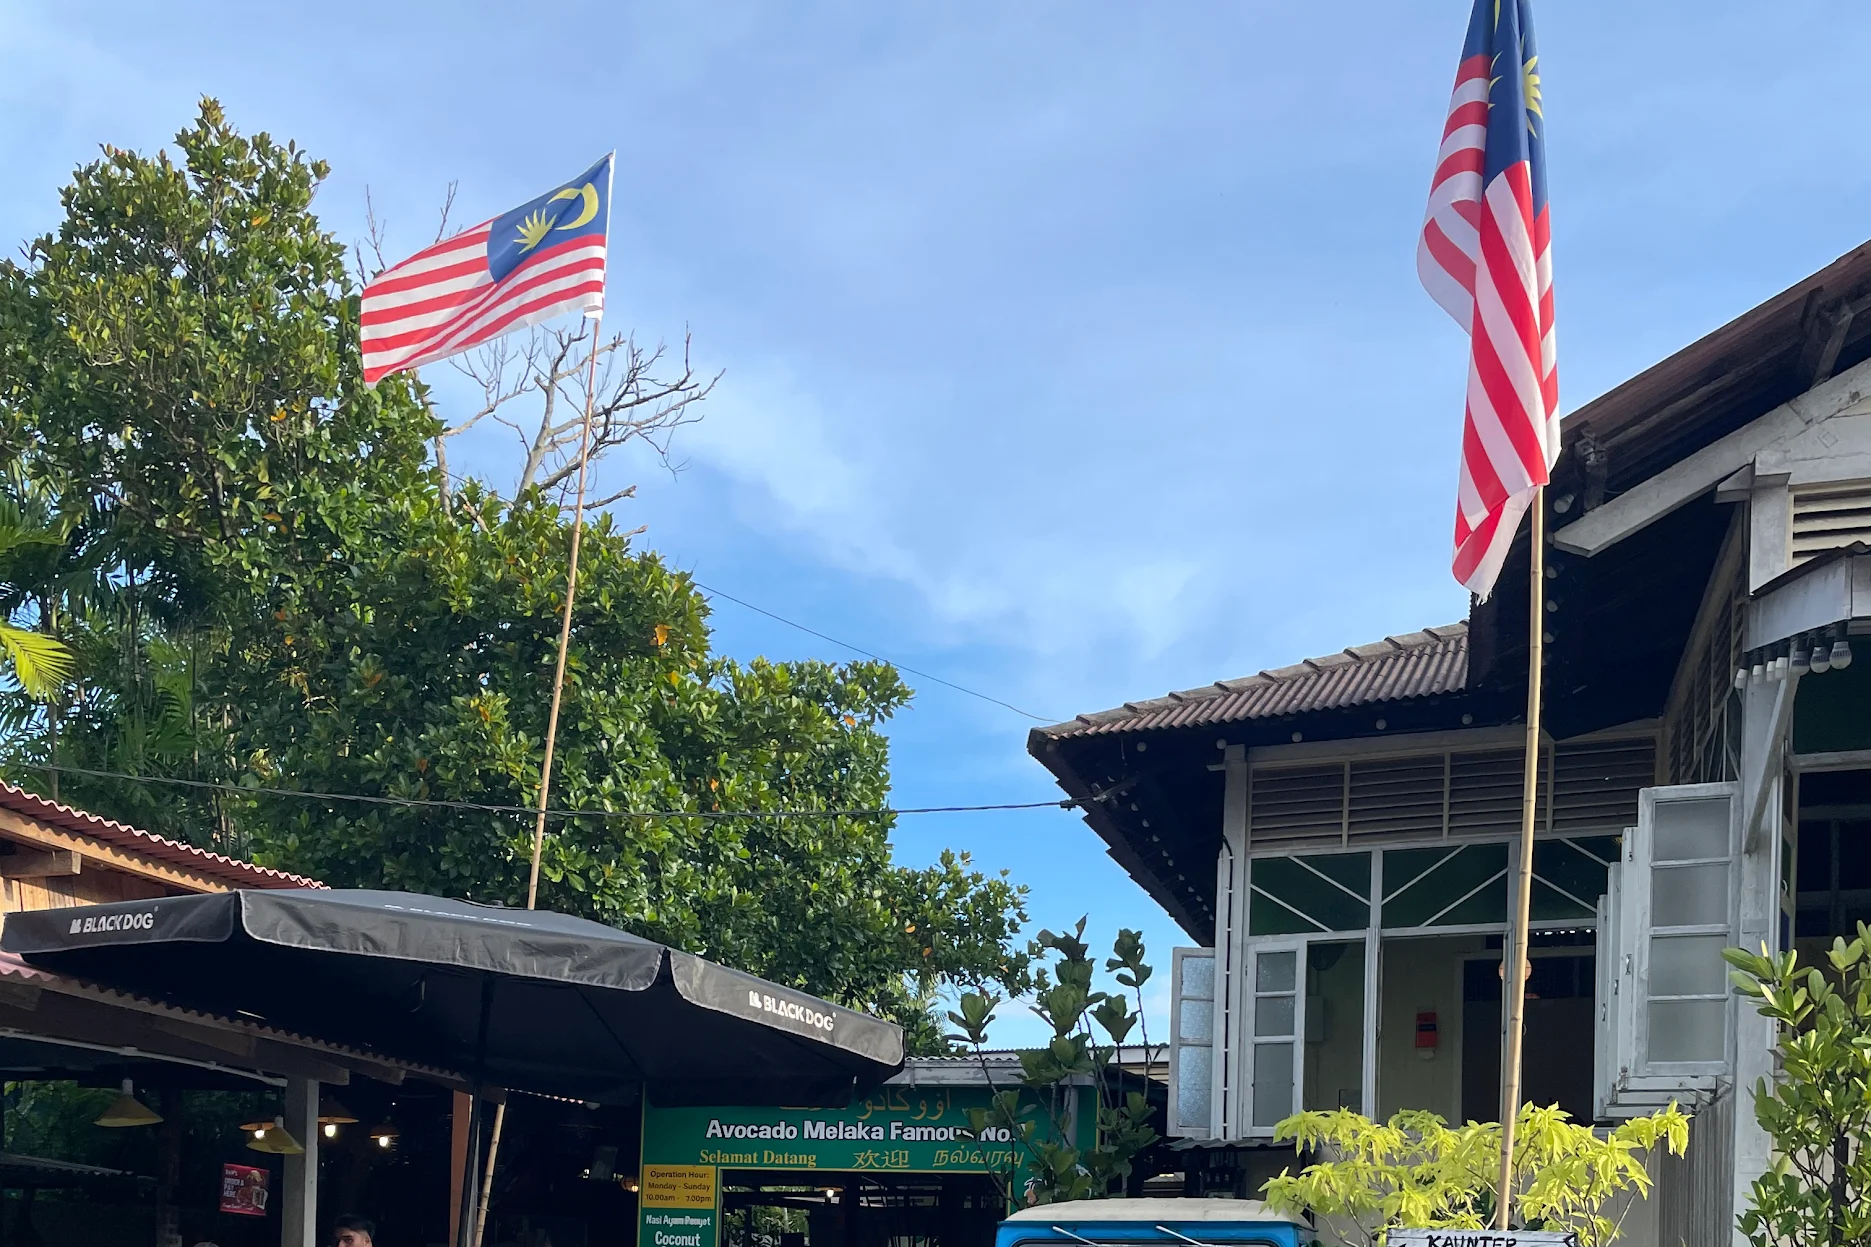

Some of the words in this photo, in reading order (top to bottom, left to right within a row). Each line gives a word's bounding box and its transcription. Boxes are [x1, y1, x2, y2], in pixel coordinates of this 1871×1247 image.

[706, 1119, 798, 1140] Avocado
[803, 1120, 884, 1141] Melaka
[699, 1150, 759, 1164] Selamat
[763, 1150, 817, 1167] Datang
[852, 1149, 910, 1169] 欢迎
[650, 1170, 686, 1179] Operation
[648, 1182, 676, 1191] Monday
[683, 1182, 711, 1192] Sunday
[645, 1193, 675, 1201] 10.00am
[685, 1195, 712, 1203] 7.00pm
[646, 1214, 662, 1224] Nasi
[655, 1230, 701, 1246] Coconut
